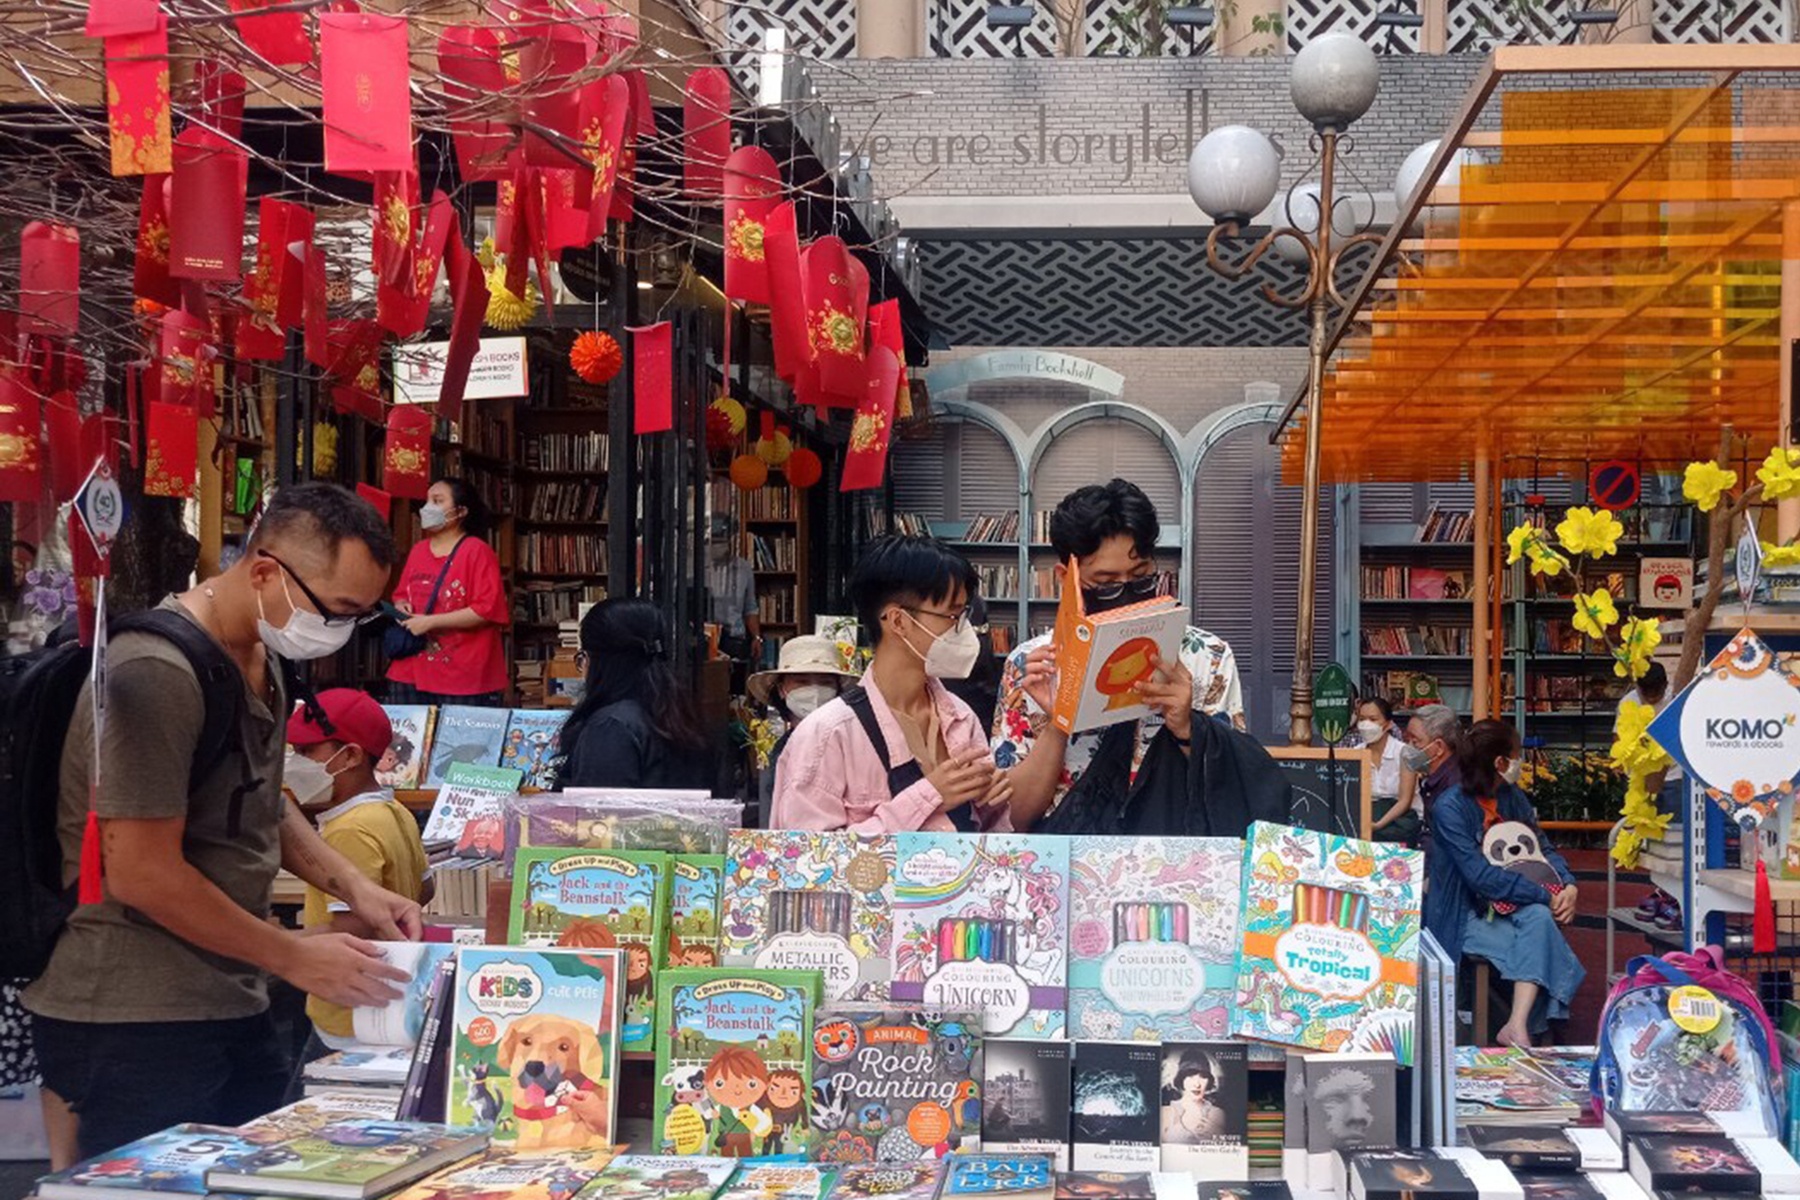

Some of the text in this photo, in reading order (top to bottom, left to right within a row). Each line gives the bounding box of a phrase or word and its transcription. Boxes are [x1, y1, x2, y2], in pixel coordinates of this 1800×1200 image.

[913, 133, 992, 166] are
[1013, 89, 1286, 185] storytells
[1706, 718, 1783, 740] KOMO
[1706, 740, 1741, 748] rewards
[452, 771, 515, 790] Workbook
[558, 874, 629, 890] Jack and the
[560, 890, 627, 905] Beanstalk
[1294, 931, 1365, 953] COLOURING
[771, 951, 844, 965] METALLIC
[1118, 954, 1187, 965] COLOURING
[1286, 951, 1371, 982] Tropical
[942, 972, 1012, 983] COLOURING
[756, 983, 776, 997] Play
[932, 983, 1017, 1007] UNICORN
[704, 999, 777, 1015] Jack and the
[706, 1016, 776, 1031] Beanstalk
[873, 1029, 919, 1041] ANIMAL
[858, 1046, 936, 1079] Rock
[831, 1072, 962, 1109] Painting
[967, 1160, 1039, 1174] BAD
[957, 1173, 1042, 1189] LUCK
